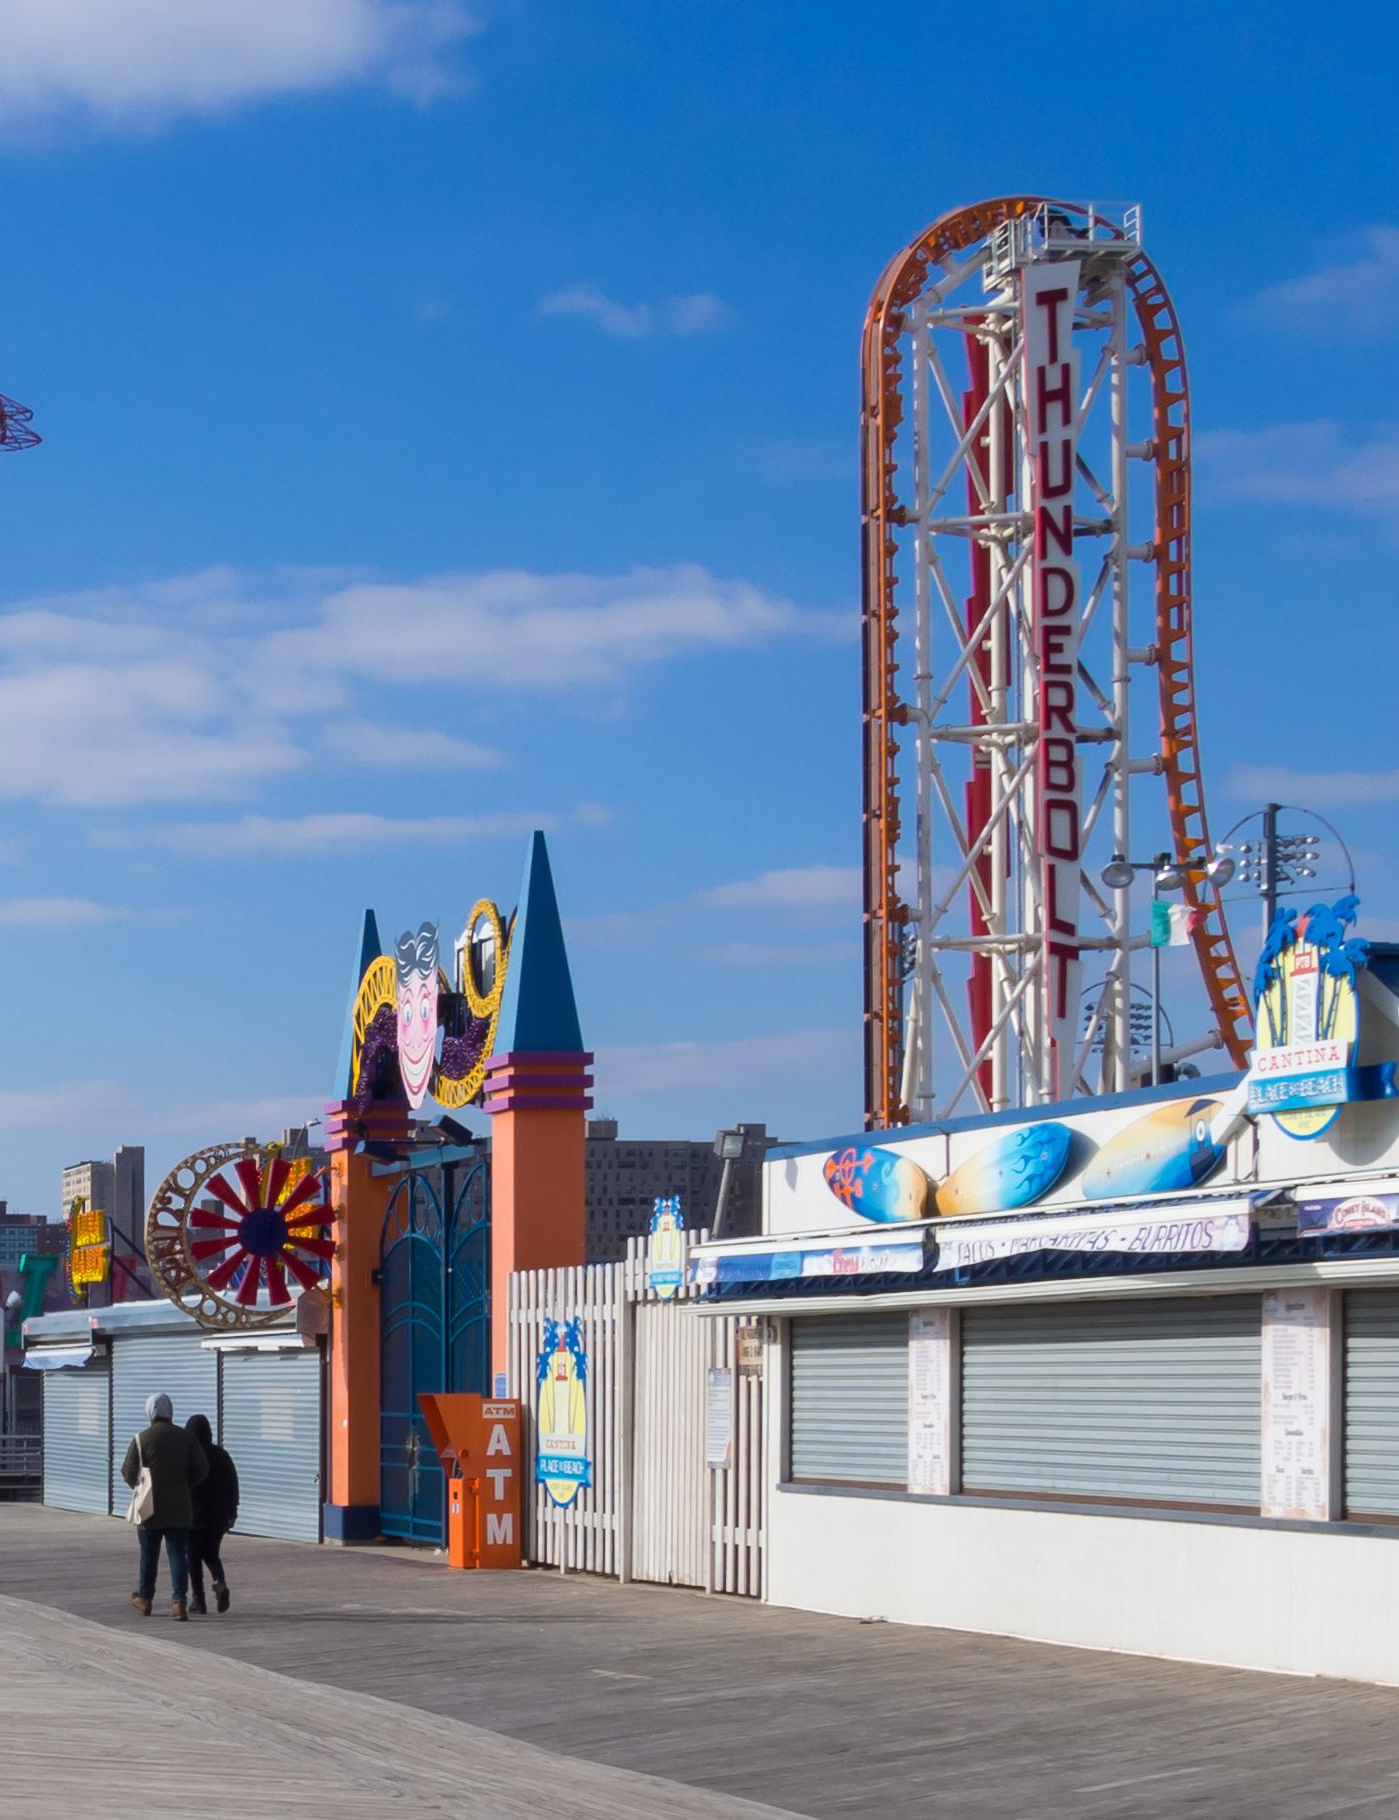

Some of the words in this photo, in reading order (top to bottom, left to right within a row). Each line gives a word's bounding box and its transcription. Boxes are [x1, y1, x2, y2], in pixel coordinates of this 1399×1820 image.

[1036, 288, 1078, 1019] THUNDERBOLT
[1257, 1045, 1341, 1073] CANTINA
[1127, 1220, 1214, 1251] BURRITOS
[484, 1407, 515, 1417] ATM
[546, 1439, 576, 1450] CANTINA
[486, 1424, 513, 1545] ATM
